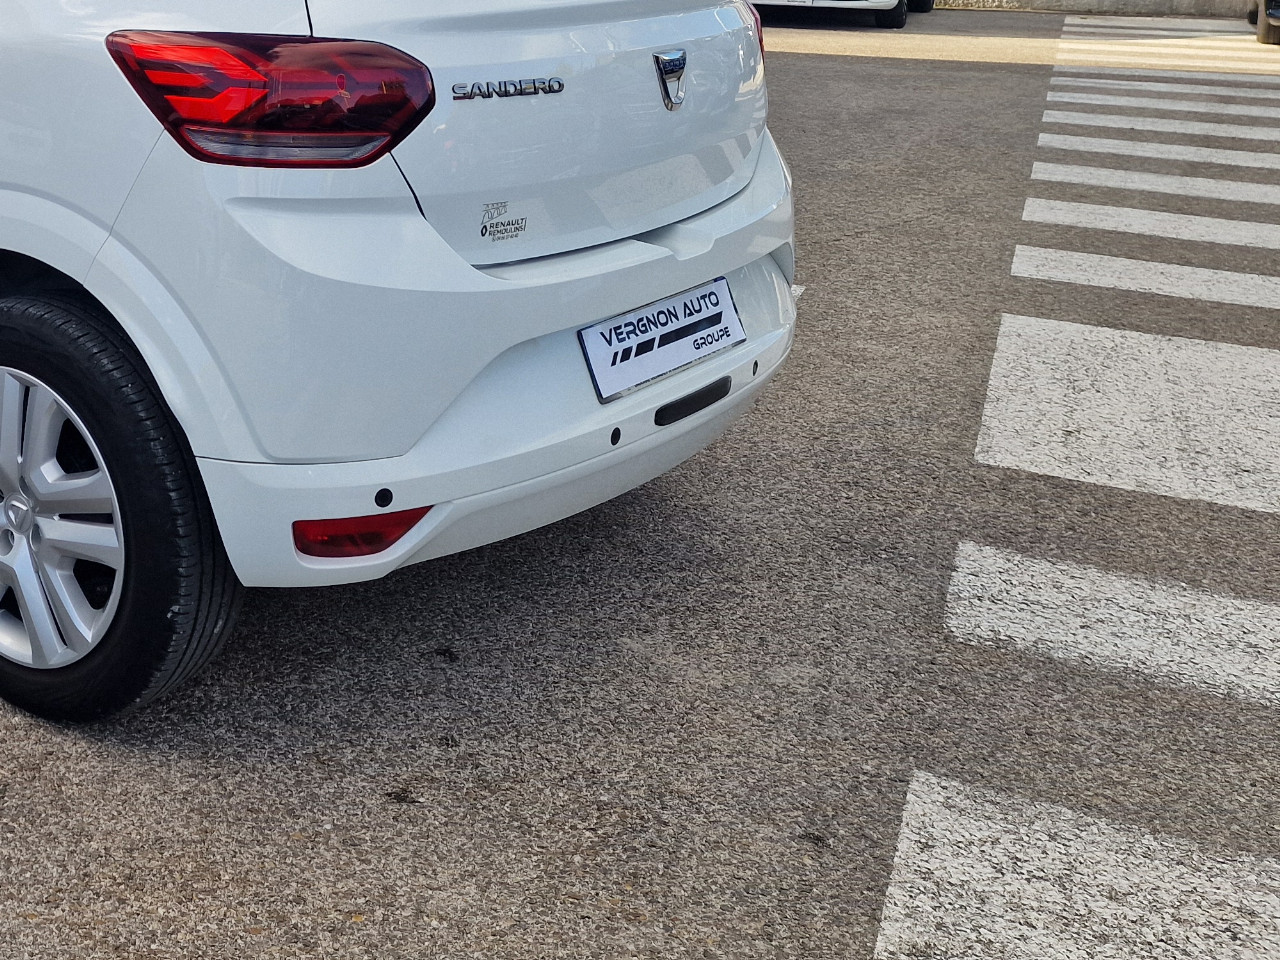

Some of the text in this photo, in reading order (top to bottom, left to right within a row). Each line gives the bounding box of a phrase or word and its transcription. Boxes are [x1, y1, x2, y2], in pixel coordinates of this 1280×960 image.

[452, 77, 564, 100] SANDERO
[490, 218, 524, 229] RENAULT
[600, 291, 720, 346] VERGNON AUTO
[693, 327, 731, 350] GROUPE
